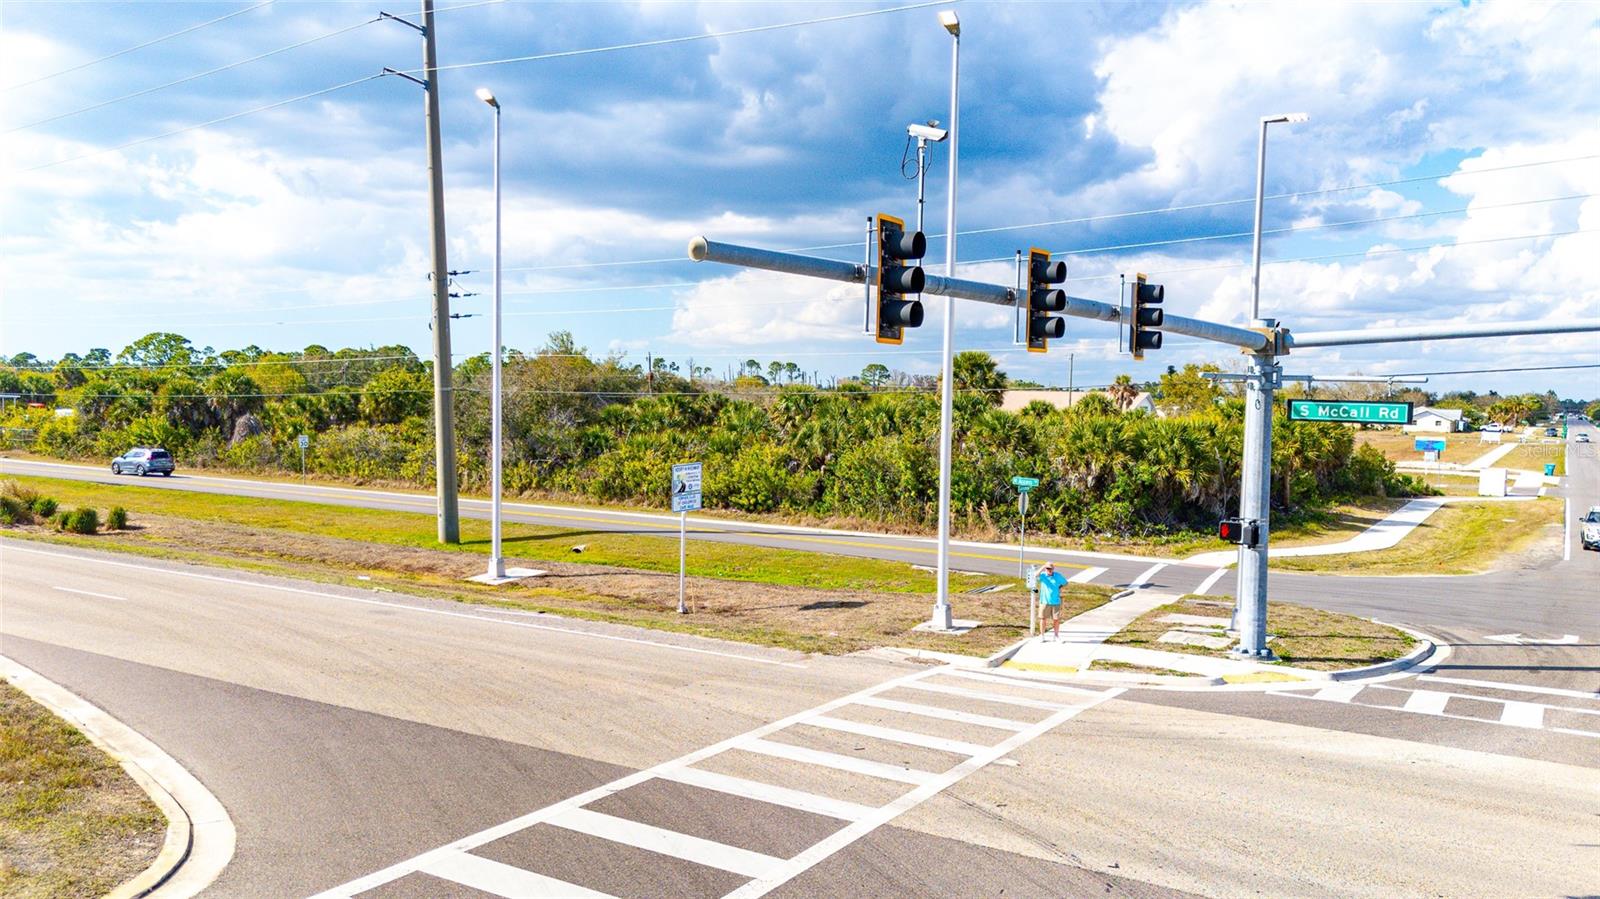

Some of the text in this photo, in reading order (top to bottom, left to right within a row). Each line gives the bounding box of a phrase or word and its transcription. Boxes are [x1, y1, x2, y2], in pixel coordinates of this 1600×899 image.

[1300, 405, 1399, 419] S McCall Rd
